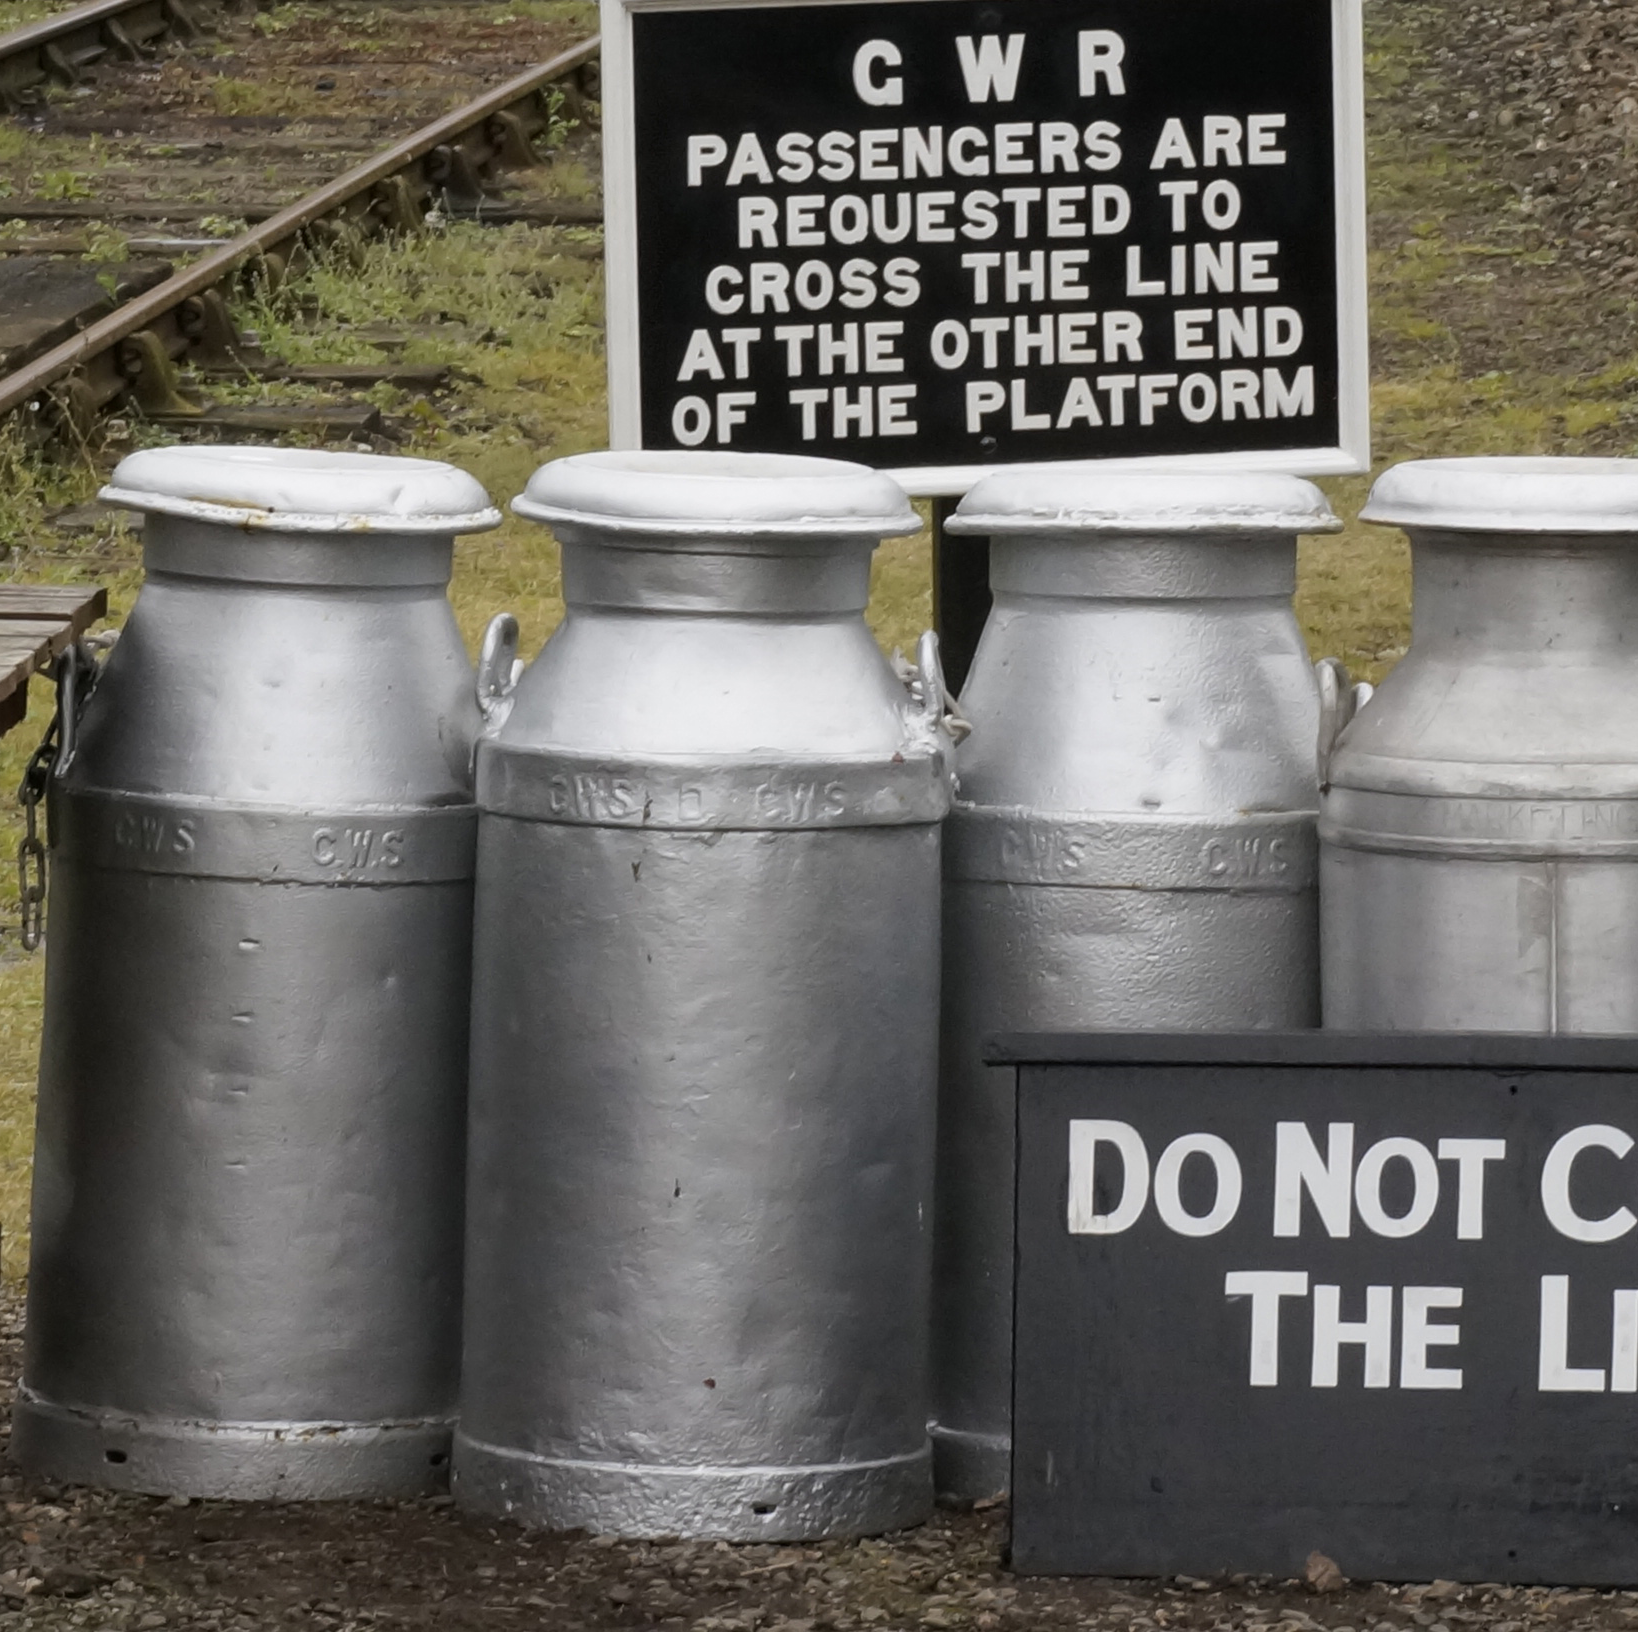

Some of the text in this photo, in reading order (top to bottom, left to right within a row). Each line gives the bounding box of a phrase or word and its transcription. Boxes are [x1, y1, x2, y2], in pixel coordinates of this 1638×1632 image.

[687, 113, 1287, 187] PASSENGERS ARE
[738, 179, 1241, 249] REQUESTED TO
[705, 240, 1279, 315] CROSS THE LINE
[677, 306, 1303, 382] AT THE OTHER END
[672, 365, 1315, 446] OF THE PLATFORM
